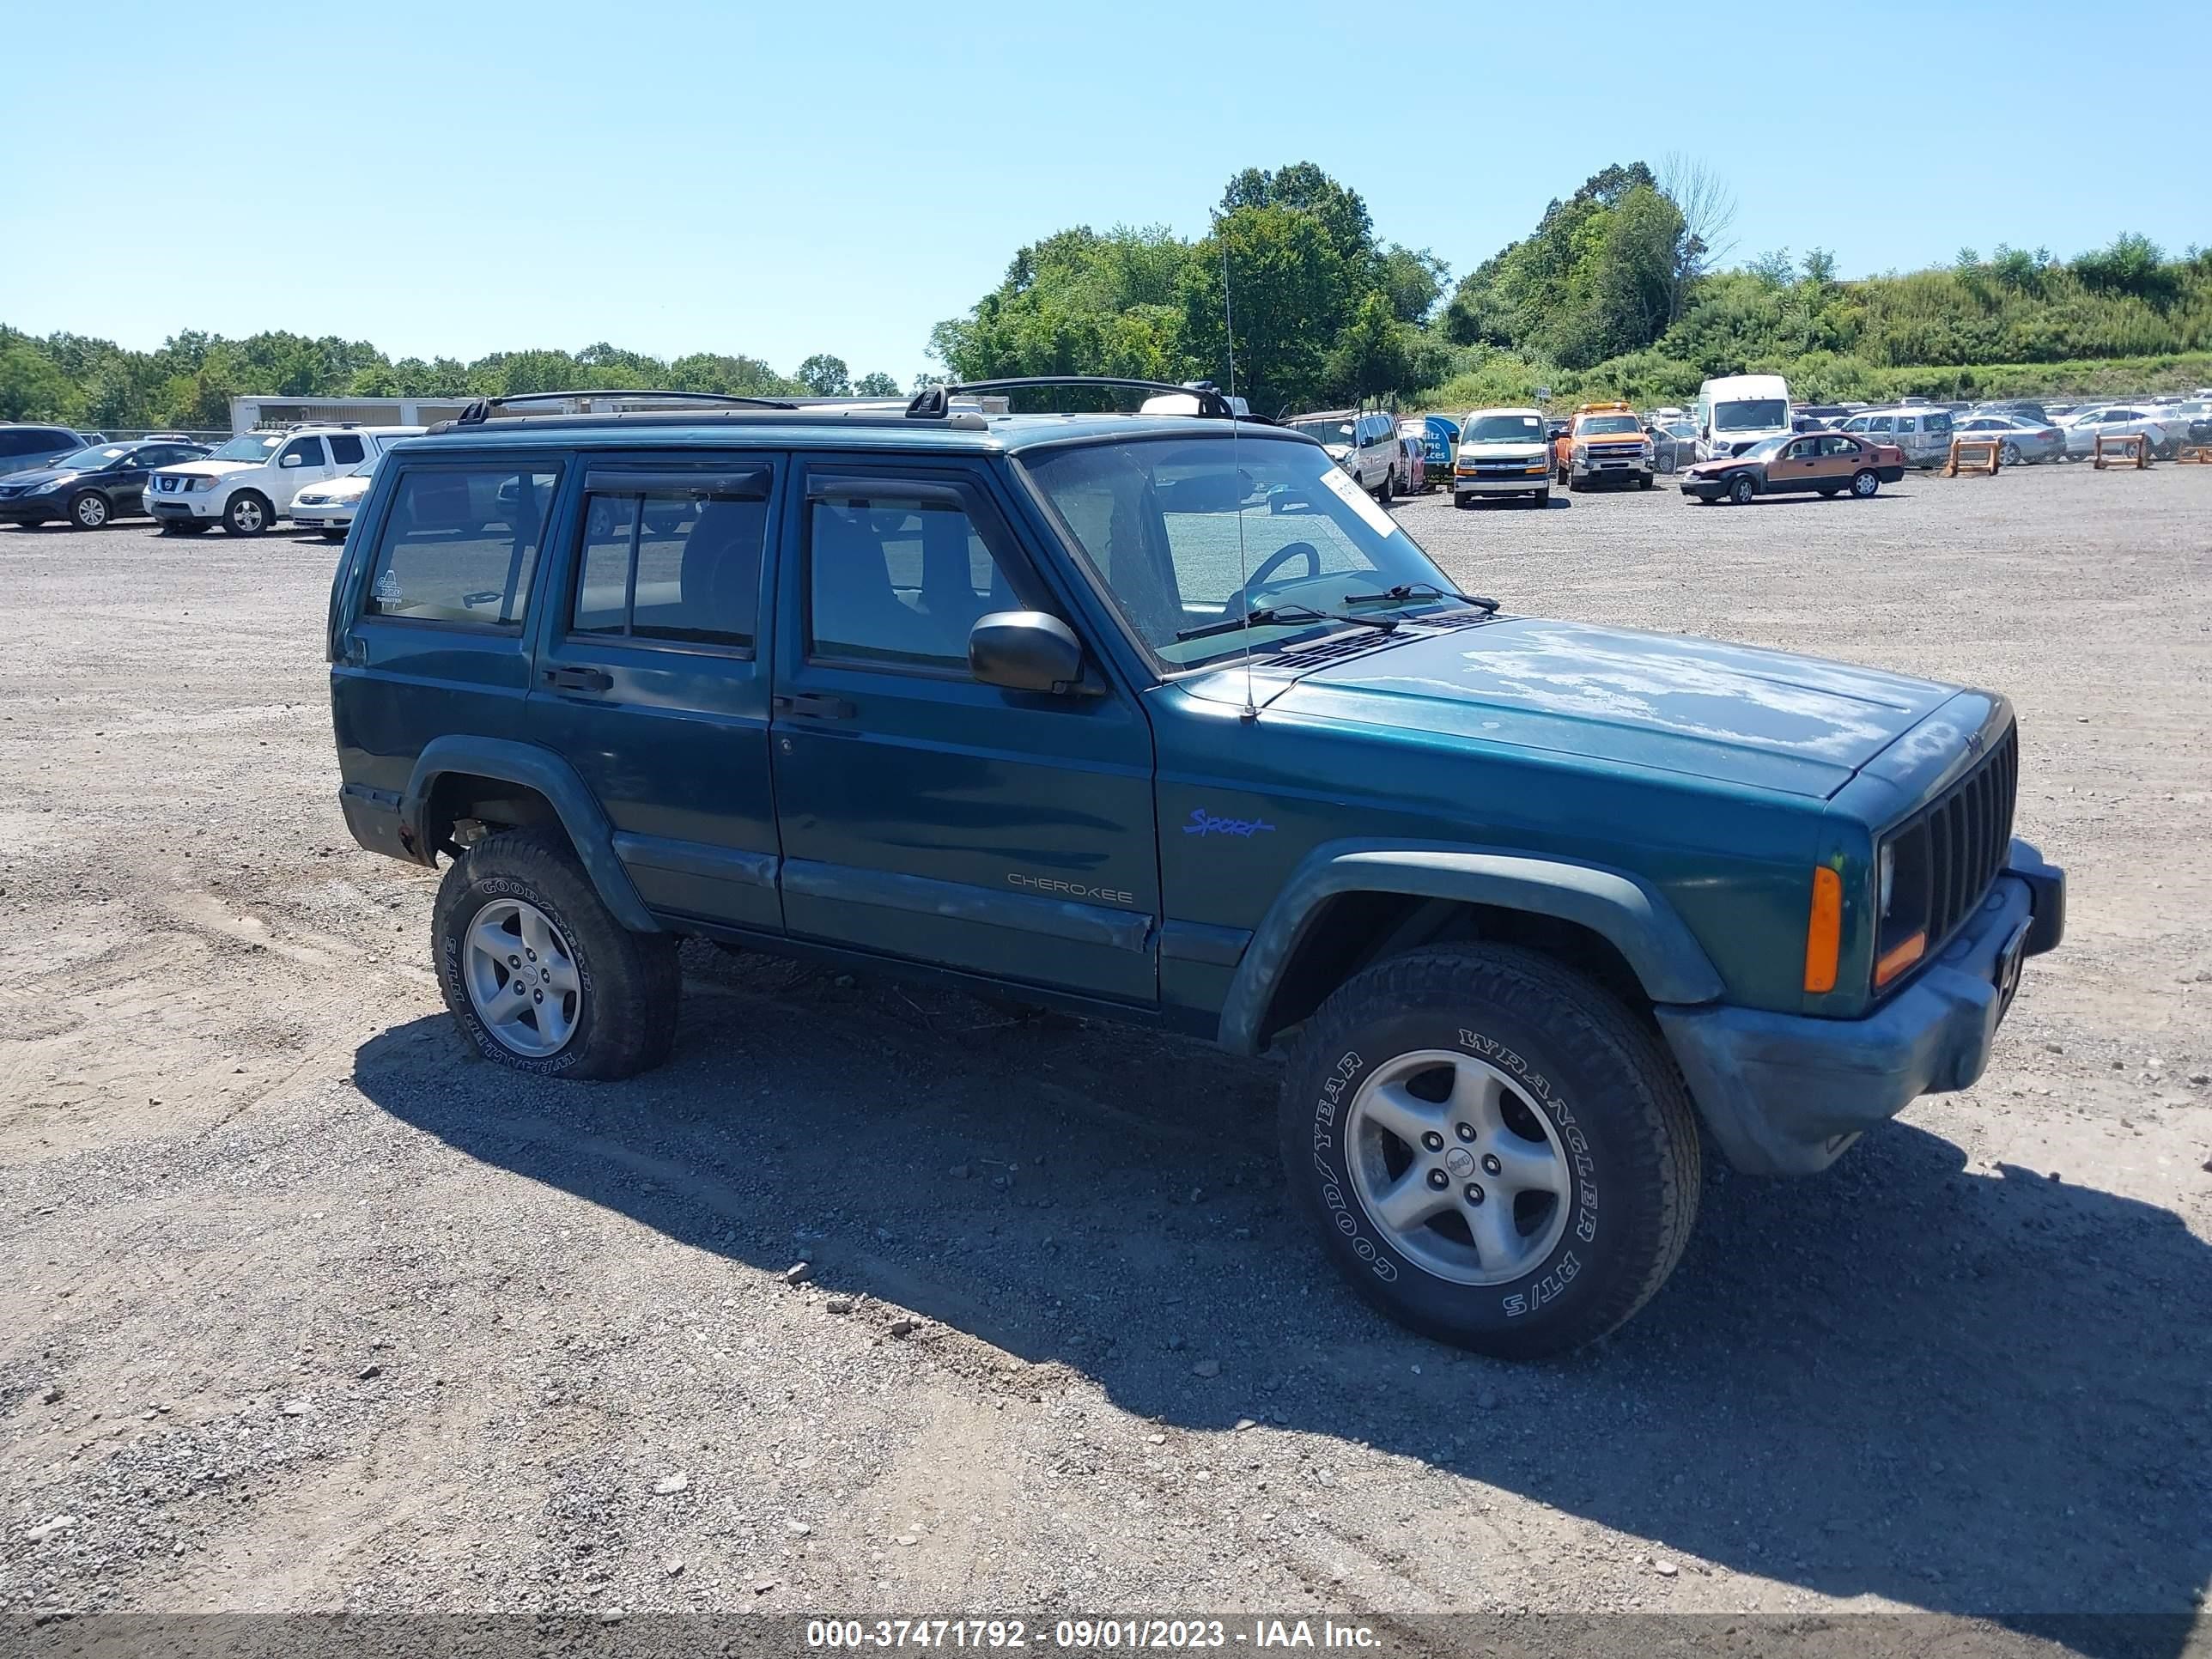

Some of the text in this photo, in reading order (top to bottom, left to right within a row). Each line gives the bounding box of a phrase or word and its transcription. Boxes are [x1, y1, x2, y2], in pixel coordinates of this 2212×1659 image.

[1007, 873, 1133, 904] CHEROKEE
[1458, 1029, 1599, 1243] WRANGLER
[1502, 1249, 1582, 1317] RT/S
